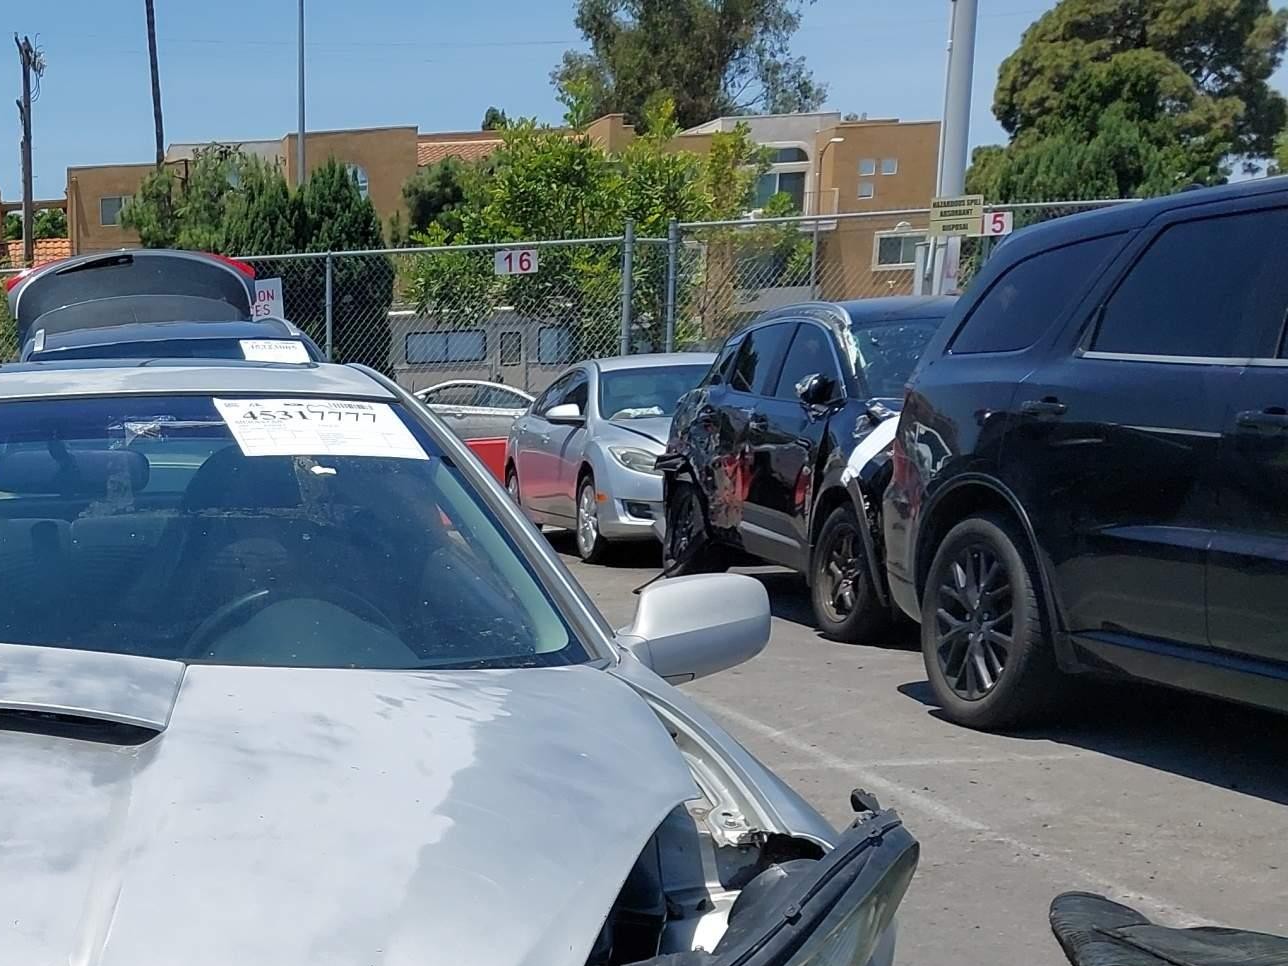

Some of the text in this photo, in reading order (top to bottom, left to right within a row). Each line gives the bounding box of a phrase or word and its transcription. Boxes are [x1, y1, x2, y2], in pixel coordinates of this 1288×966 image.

[504, 252, 531, 272] 16
[252, 304, 271, 317] ES
[242, 410, 376, 423] 45317777
